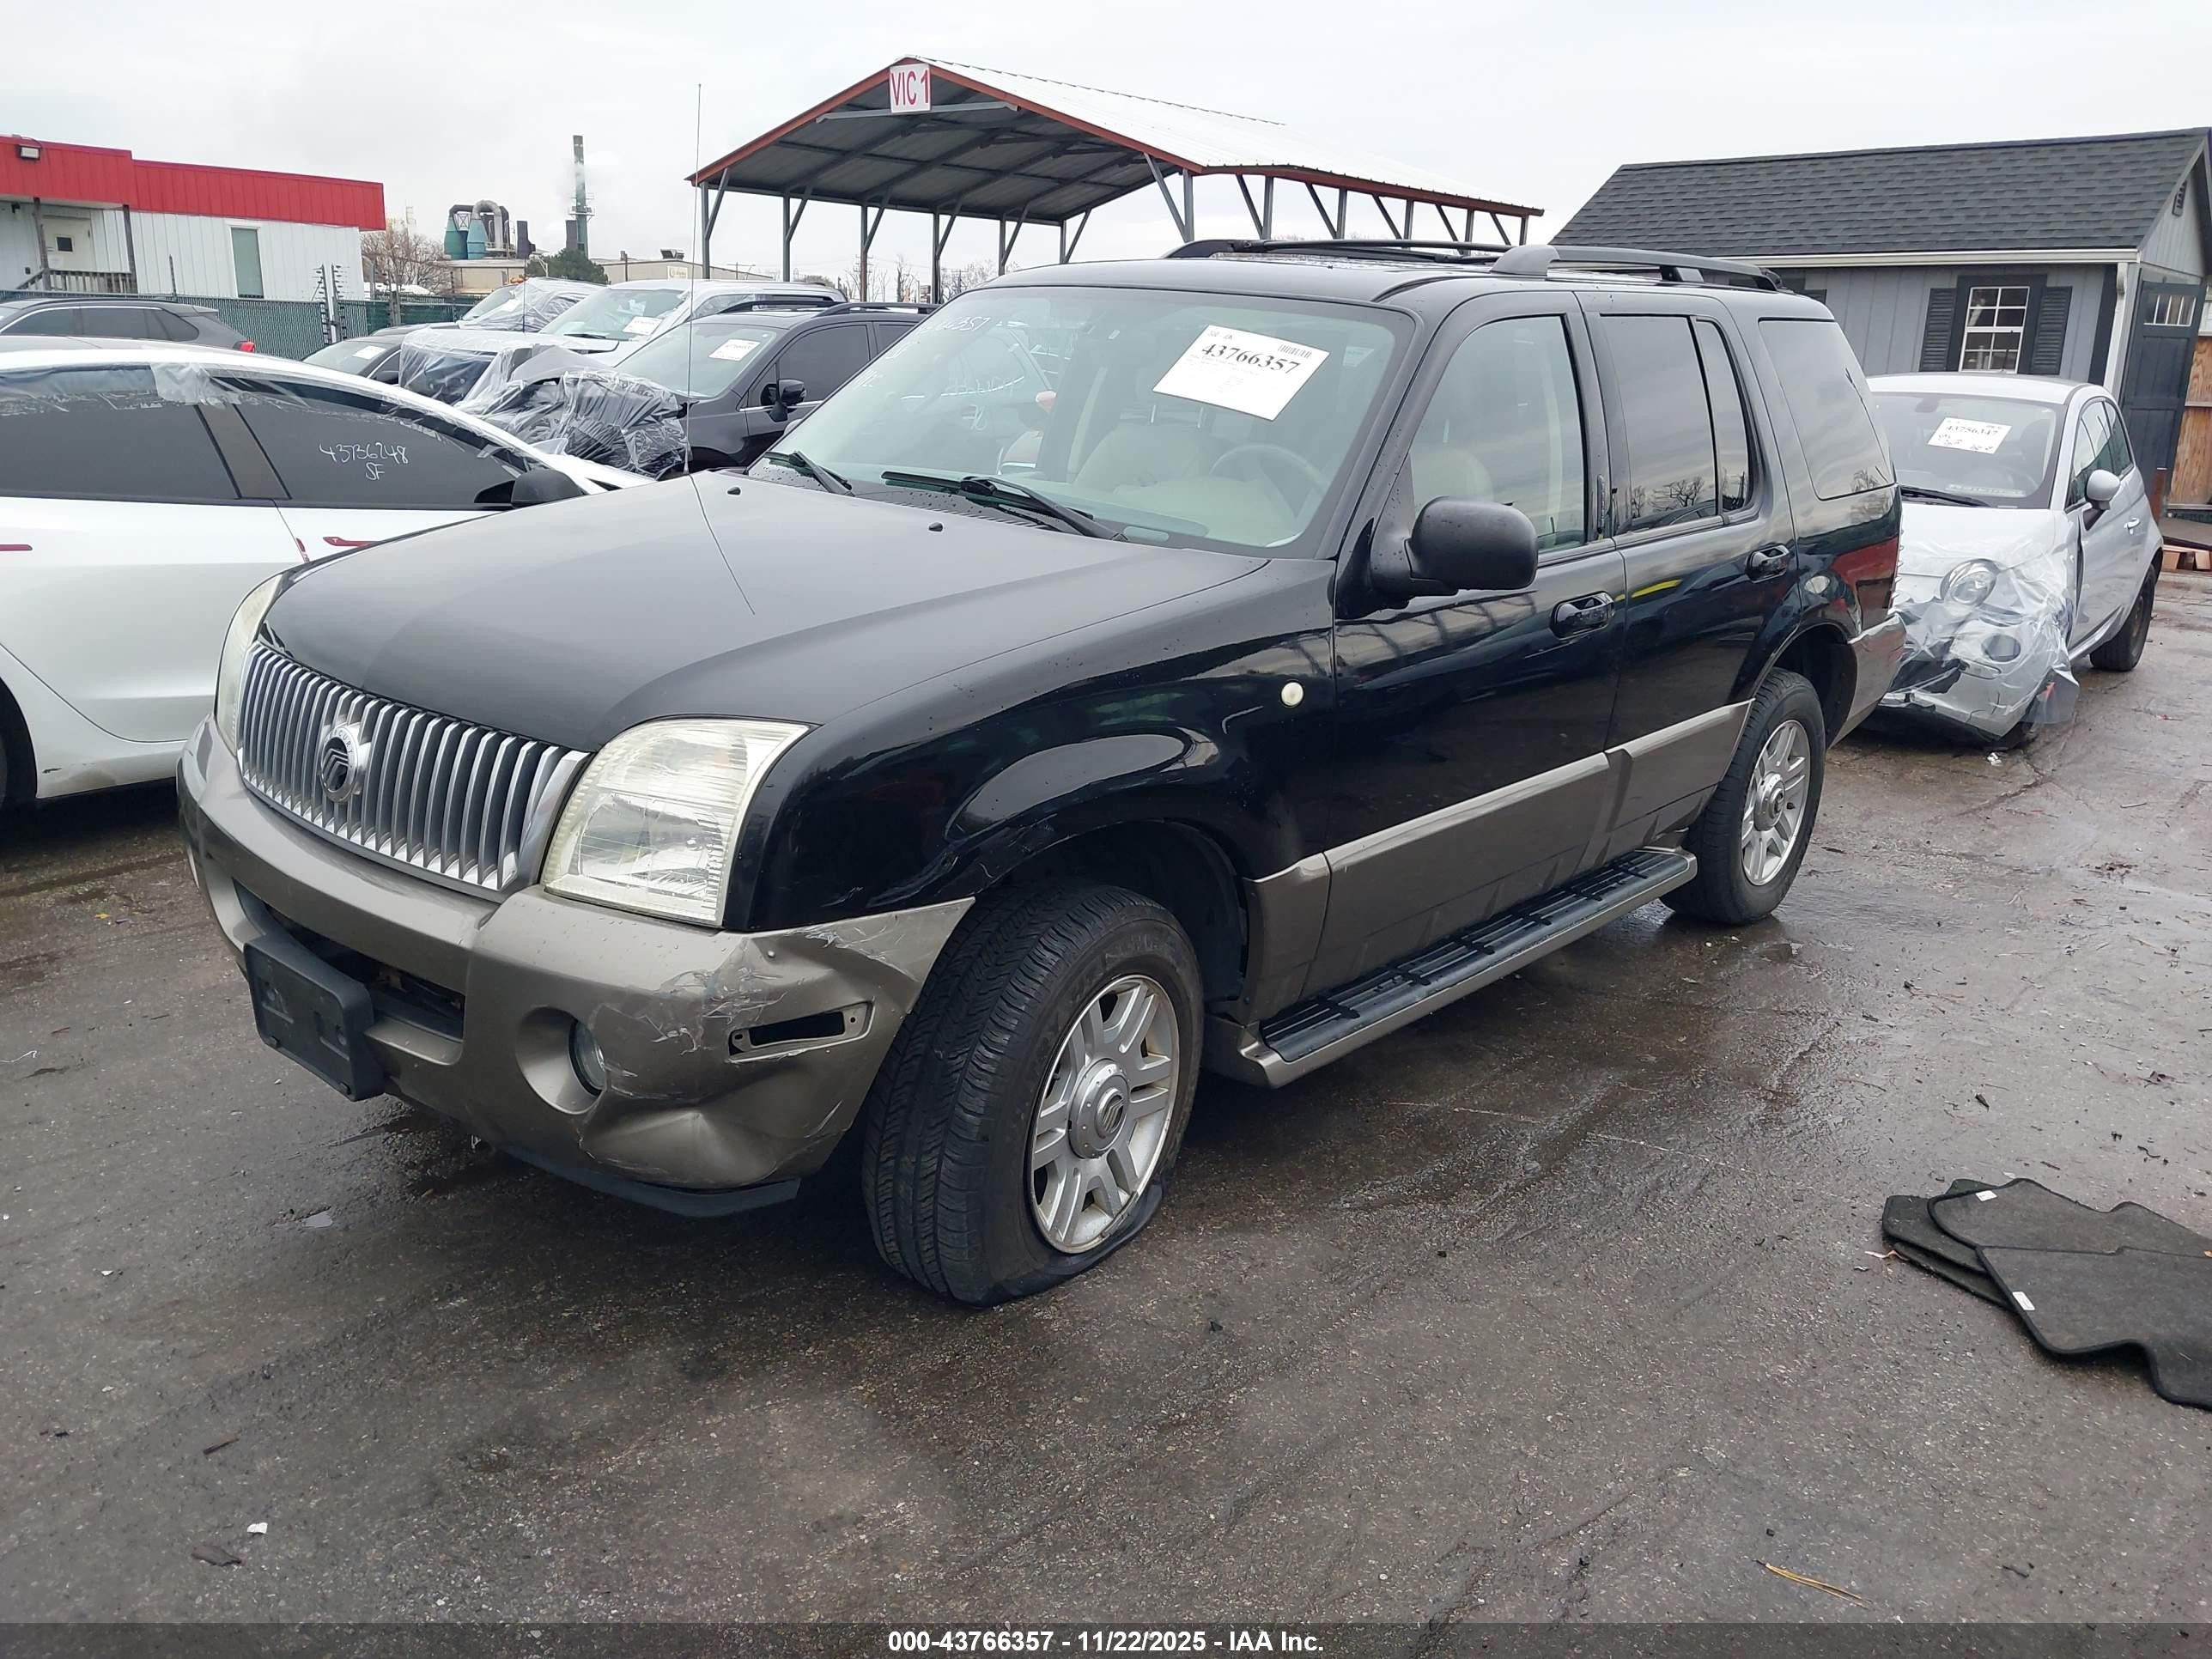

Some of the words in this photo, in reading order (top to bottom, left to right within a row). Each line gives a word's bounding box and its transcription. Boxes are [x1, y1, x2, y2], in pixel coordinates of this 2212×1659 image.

[890, 70, 917, 106] VIC
[920, 69, 929, 104] 1
[1201, 343, 1302, 374] 43766357
[365, 462, 386, 480] SF
